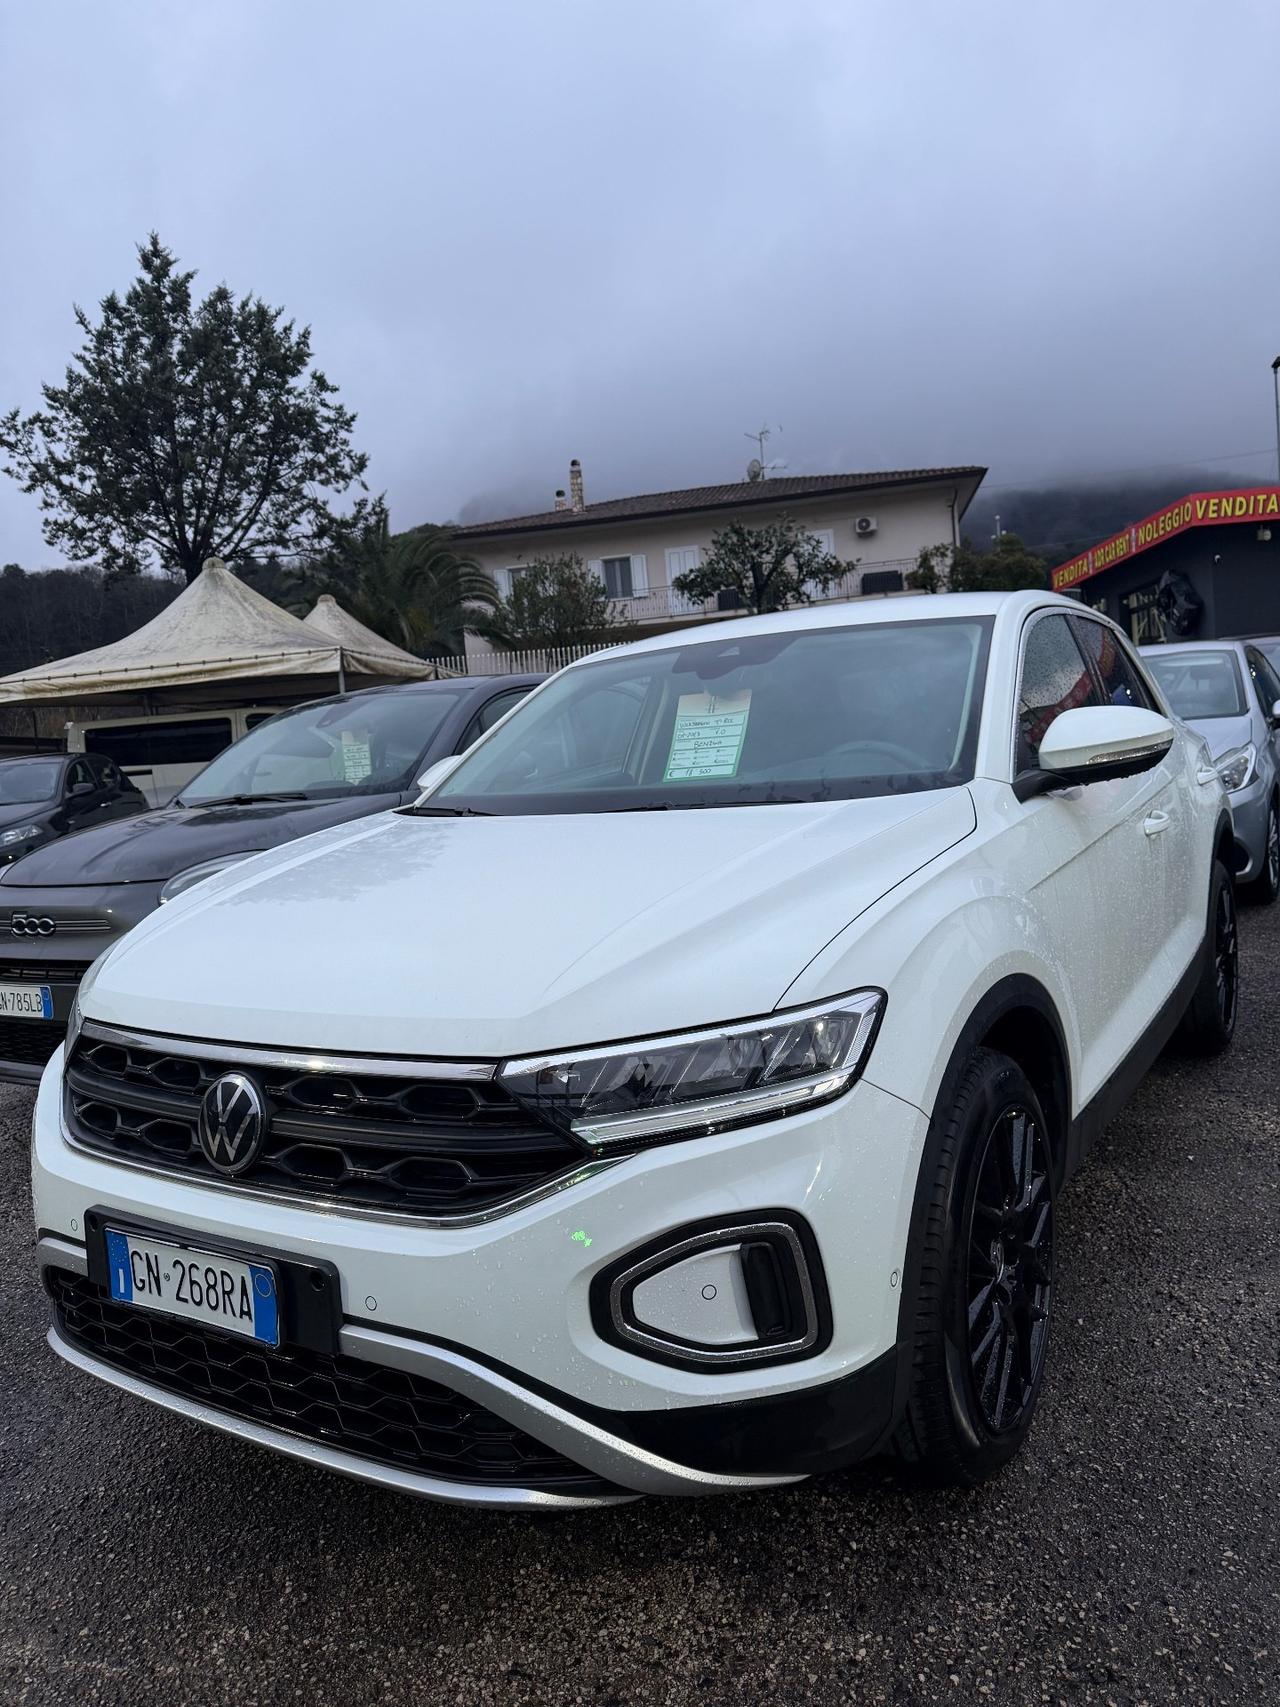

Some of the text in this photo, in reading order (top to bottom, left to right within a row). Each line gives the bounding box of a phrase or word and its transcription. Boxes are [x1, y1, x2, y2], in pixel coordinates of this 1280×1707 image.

[1196, 493, 1279, 520] VENDITA
[1138, 502, 1192, 546] NOLEGGIO
[1053, 557, 1089, 589] VENDITA
[12, 914, 55, 935] 500
